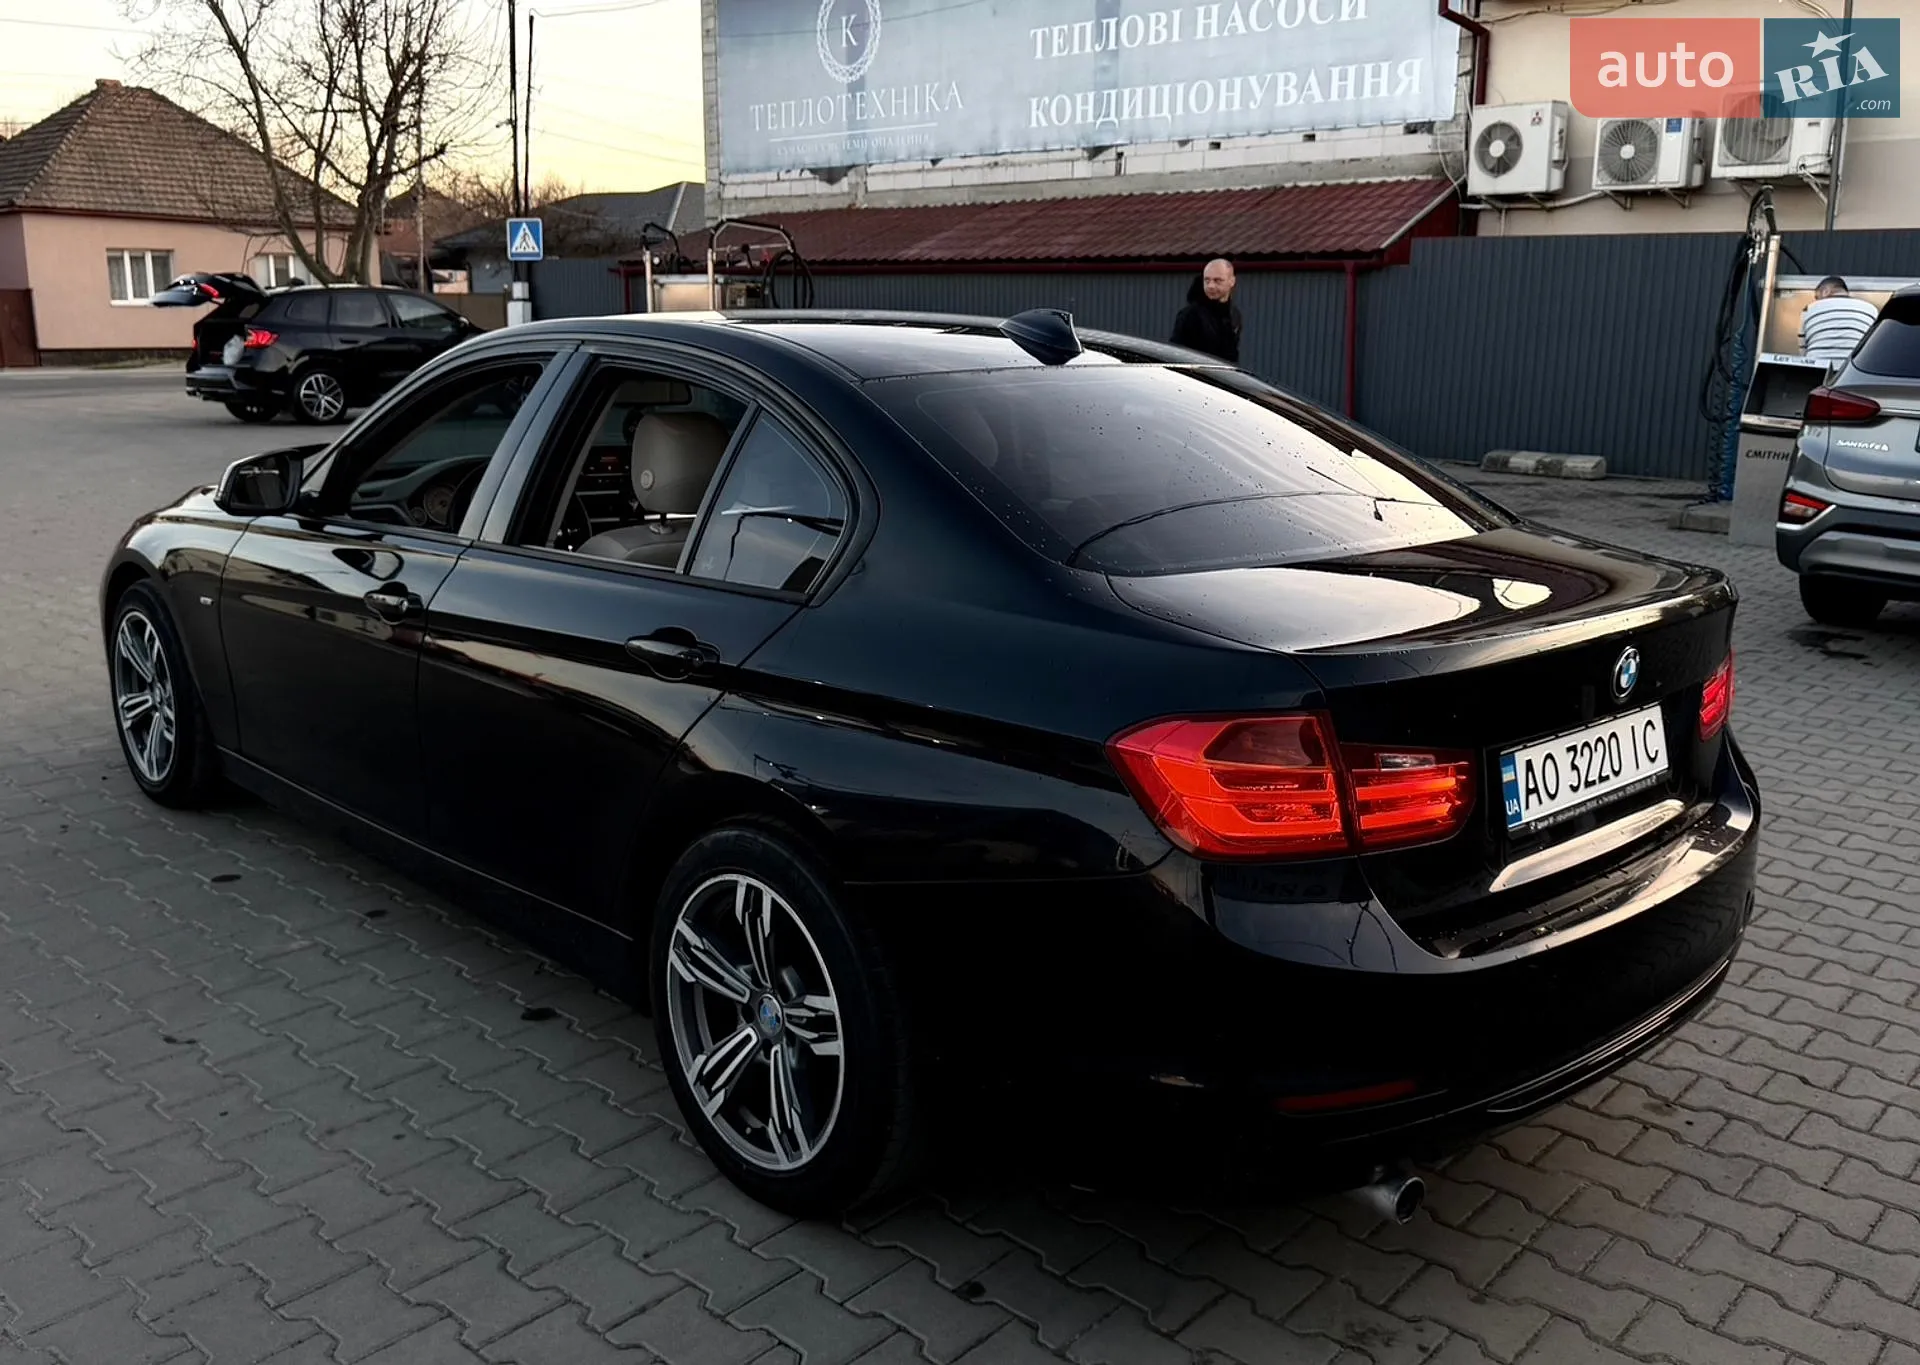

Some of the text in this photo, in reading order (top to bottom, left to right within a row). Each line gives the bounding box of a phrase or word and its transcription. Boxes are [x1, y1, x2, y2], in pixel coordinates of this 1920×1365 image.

[1030, 8, 1183, 60] ТЕПЛОВІ
[750, 80, 964, 131] ТЕПЛОТЕХНІКА
[1028, 57, 1424, 131] КОНДИЦІОНУВАННЯ
[1524, 751, 1560, 811] AO
[1566, 731, 1622, 793] 3220
[1630, 719, 1660, 770] IC
[1505, 800, 1520, 816] UA
